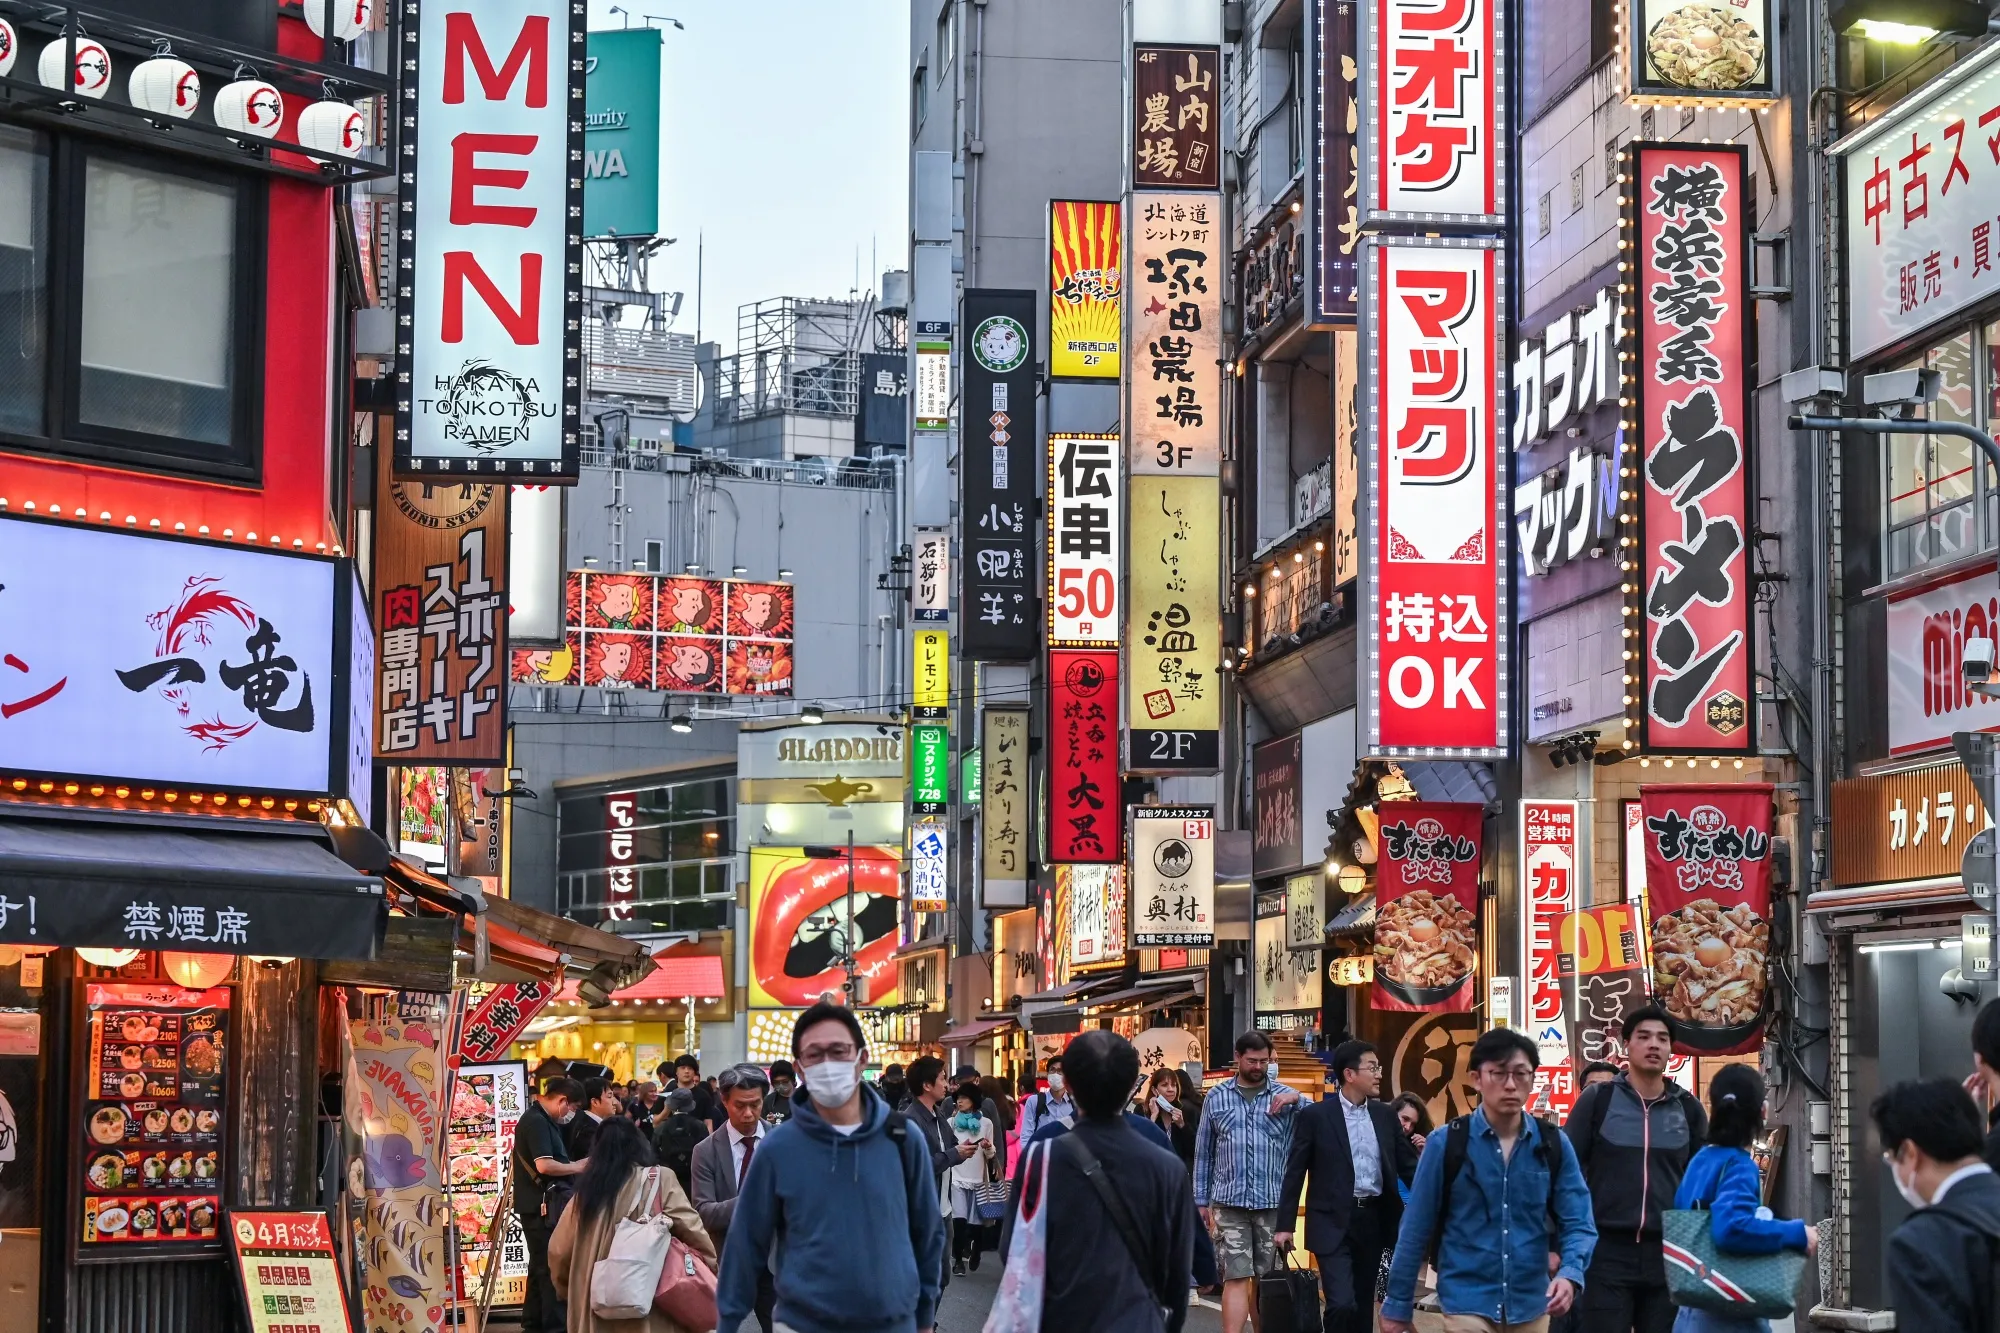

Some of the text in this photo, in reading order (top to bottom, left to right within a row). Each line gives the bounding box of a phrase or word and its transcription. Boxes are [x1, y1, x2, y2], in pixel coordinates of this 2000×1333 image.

[1139, 52, 1157, 63] 4F
[1175, 53, 1212, 133] 山内
[1138, 92, 1179, 178] 農場
[441, 12, 549, 346] MEN
[1144, 202, 1209, 224] 北海道
[1145, 228, 1210, 243] シントク町
[1900, 217, 2000, 316] 販売・買
[926, 322, 942, 333] 6F
[1145, 247, 1208, 429] 塚田農場
[1068, 341, 1118, 352] 新宿西口店
[1084, 354, 1100, 365] 2F
[434, 375, 540, 393] HAKATA
[1396, 270, 1477, 486] マック
[1513, 286, 1624, 453] カラオ
[418, 399, 557, 418] TONKOTSU
[927, 419, 938, 427] 6F
[444, 425, 530, 441] RAMEN
[992, 383, 1009, 489] 中国火鍋専門店
[1156, 440, 1193, 469] 3F
[1058, 441, 1112, 560] 伝串
[1514, 446, 1594, 578] マック
[1337, 529, 1350, 576] 3F
[919, 541, 938, 604] 石狩川
[1057, 567, 1115, 619] 50
[924, 609, 939, 619] 4F
[1079, 621, 1093, 636] 円
[1386, 592, 1489, 644] 持込
[421, 562, 459, 743] ステーキ
[1144, 603, 1204, 700] 温野菜
[114, 616, 316, 734] 一竜
[381, 584, 420, 753] 肉専門店
[1388, 655, 1486, 710] OK
[923, 706, 938, 718] 3F
[1063, 701, 1084, 769] 焼きとん
[1085, 702, 1107, 763] 立呑み
[1150, 731, 1197, 760] 2F
[778, 736, 900, 762] ALADDIN
[924, 744, 936, 788] スタジオ
[918, 788, 941, 800] 728
[923, 803, 937, 813] 3F
[994, 733, 1019, 872] ひまわり寿司
[1067, 771, 1105, 856] 大黒
[1137, 809, 1210, 818] 新宿グルメスクエア
[1185, 821, 1209, 839] B1
[1381, 820, 1476, 862] すためし
[1528, 825, 1571, 841] 営業中
[1646, 809, 1768, 862] すためし
[1158, 882, 1188, 892] たんや
[123, 901, 252, 945] 禁煙席
[1144, 895, 1200, 922] 奥村
[1137, 934, 1211, 944] 各種ご宴会受付中
[405, 991, 441, 1007] THAI
[461, 980, 542, 1062] 中華料
[498, 1071, 519, 1110] 天龍
[87, 1211, 97, 1239] セット
[258, 1222, 290, 1246] 4月
[289, 1222, 319, 1236] イベント
[293, 1235, 330, 1248] カレンダー
[508, 1281, 524, 1293] B1
